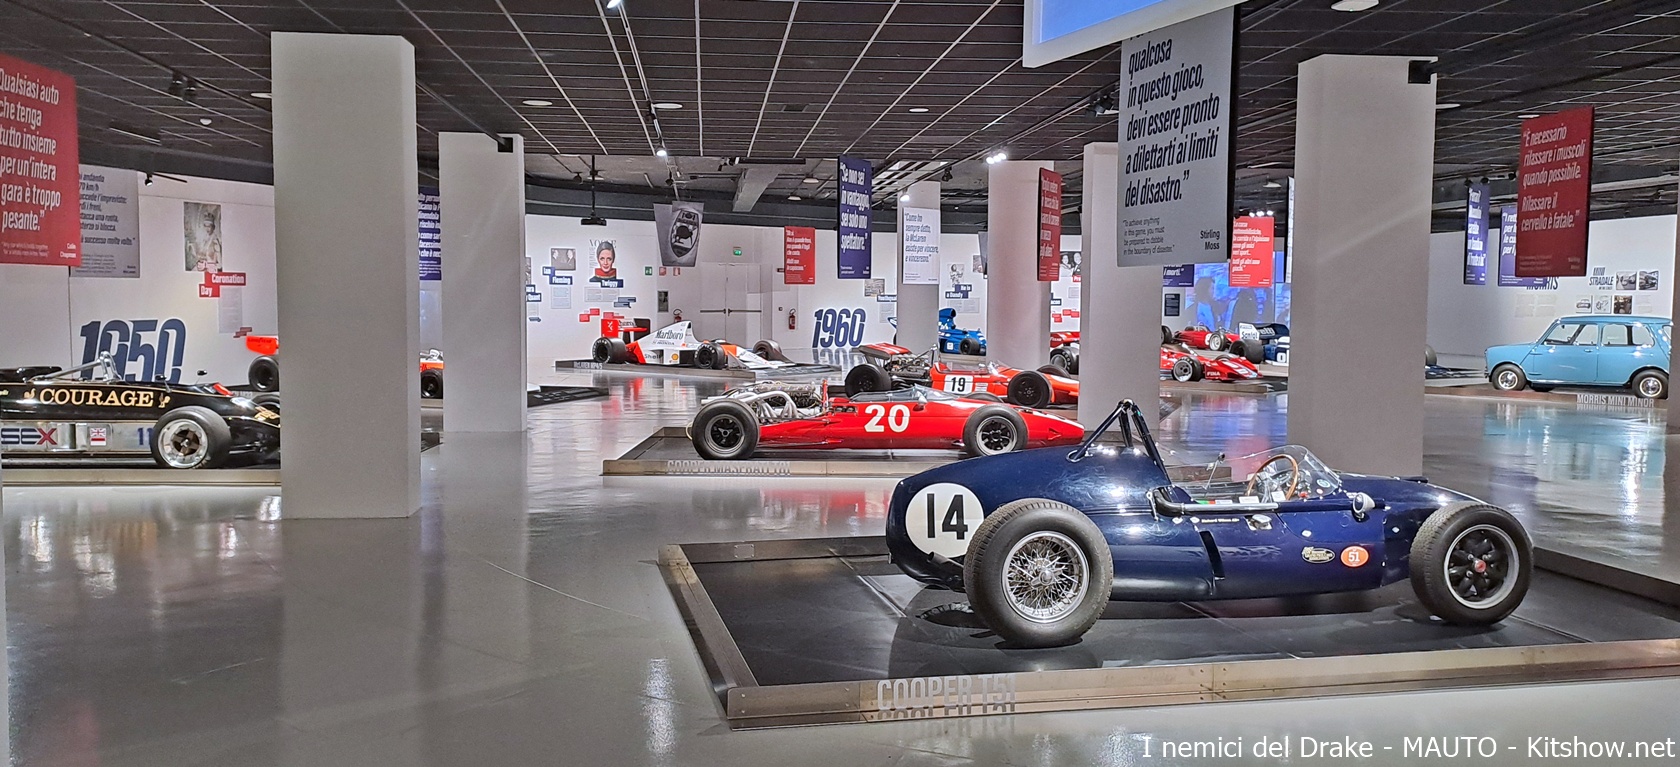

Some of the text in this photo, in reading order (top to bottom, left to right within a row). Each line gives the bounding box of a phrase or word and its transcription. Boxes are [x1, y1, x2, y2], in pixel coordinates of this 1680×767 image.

[1128, 39, 1172, 80] qualcosa
[40, 85, 59, 106] auto
[1127, 63, 1204, 110] in questo gioco,
[16, 102, 42, 130] tenga
[1127, 93, 1220, 141] devi essere pronto
[22, 128, 56, 156] insieme
[1530, 123, 1567, 146] necessario
[1126, 126, 1219, 174] a dilettarti ai limiti
[1524, 149, 1553, 167] rilassare
[1556, 139, 1587, 160] muscoli
[0, 154, 56, 180] per un'intera
[848, 170, 858, 184] non
[1523, 162, 1581, 190] quando possibile.
[1, 181, 61, 211] gara è troppo
[1125, 180, 1140, 208] del
[1522, 196, 1552, 212] Rilassare
[849, 210, 858, 228] solo
[858, 216, 868, 230] uno
[1522, 216, 1548, 232] cervello
[1200, 229, 1220, 241] Stirling
[1204, 241, 1220, 250] Moss
[212, 274, 244, 284] Coronation
[552, 276, 571, 286] Fleming
[602, 280, 618, 288] Twiggy
[200, 286, 212, 297] Day
[656, 330, 684, 340] Marlboro
[812, 308, 866, 348] 1960
[80, 318, 187, 384] 1950
[952, 376, 966, 392] 19
[39, 388, 154, 408] COURAGE
[1577, 394, 1654, 408] MORRIS MINI MINOR
[864, 404, 911, 433] 20
[667, 460, 712, 474] COOPER
[714, 460, 772, 475] MASERATI
[926, 493, 968, 540] 14
[1348, 552, 1360, 562] 51
[877, 672, 1016, 710] COOPER T51
